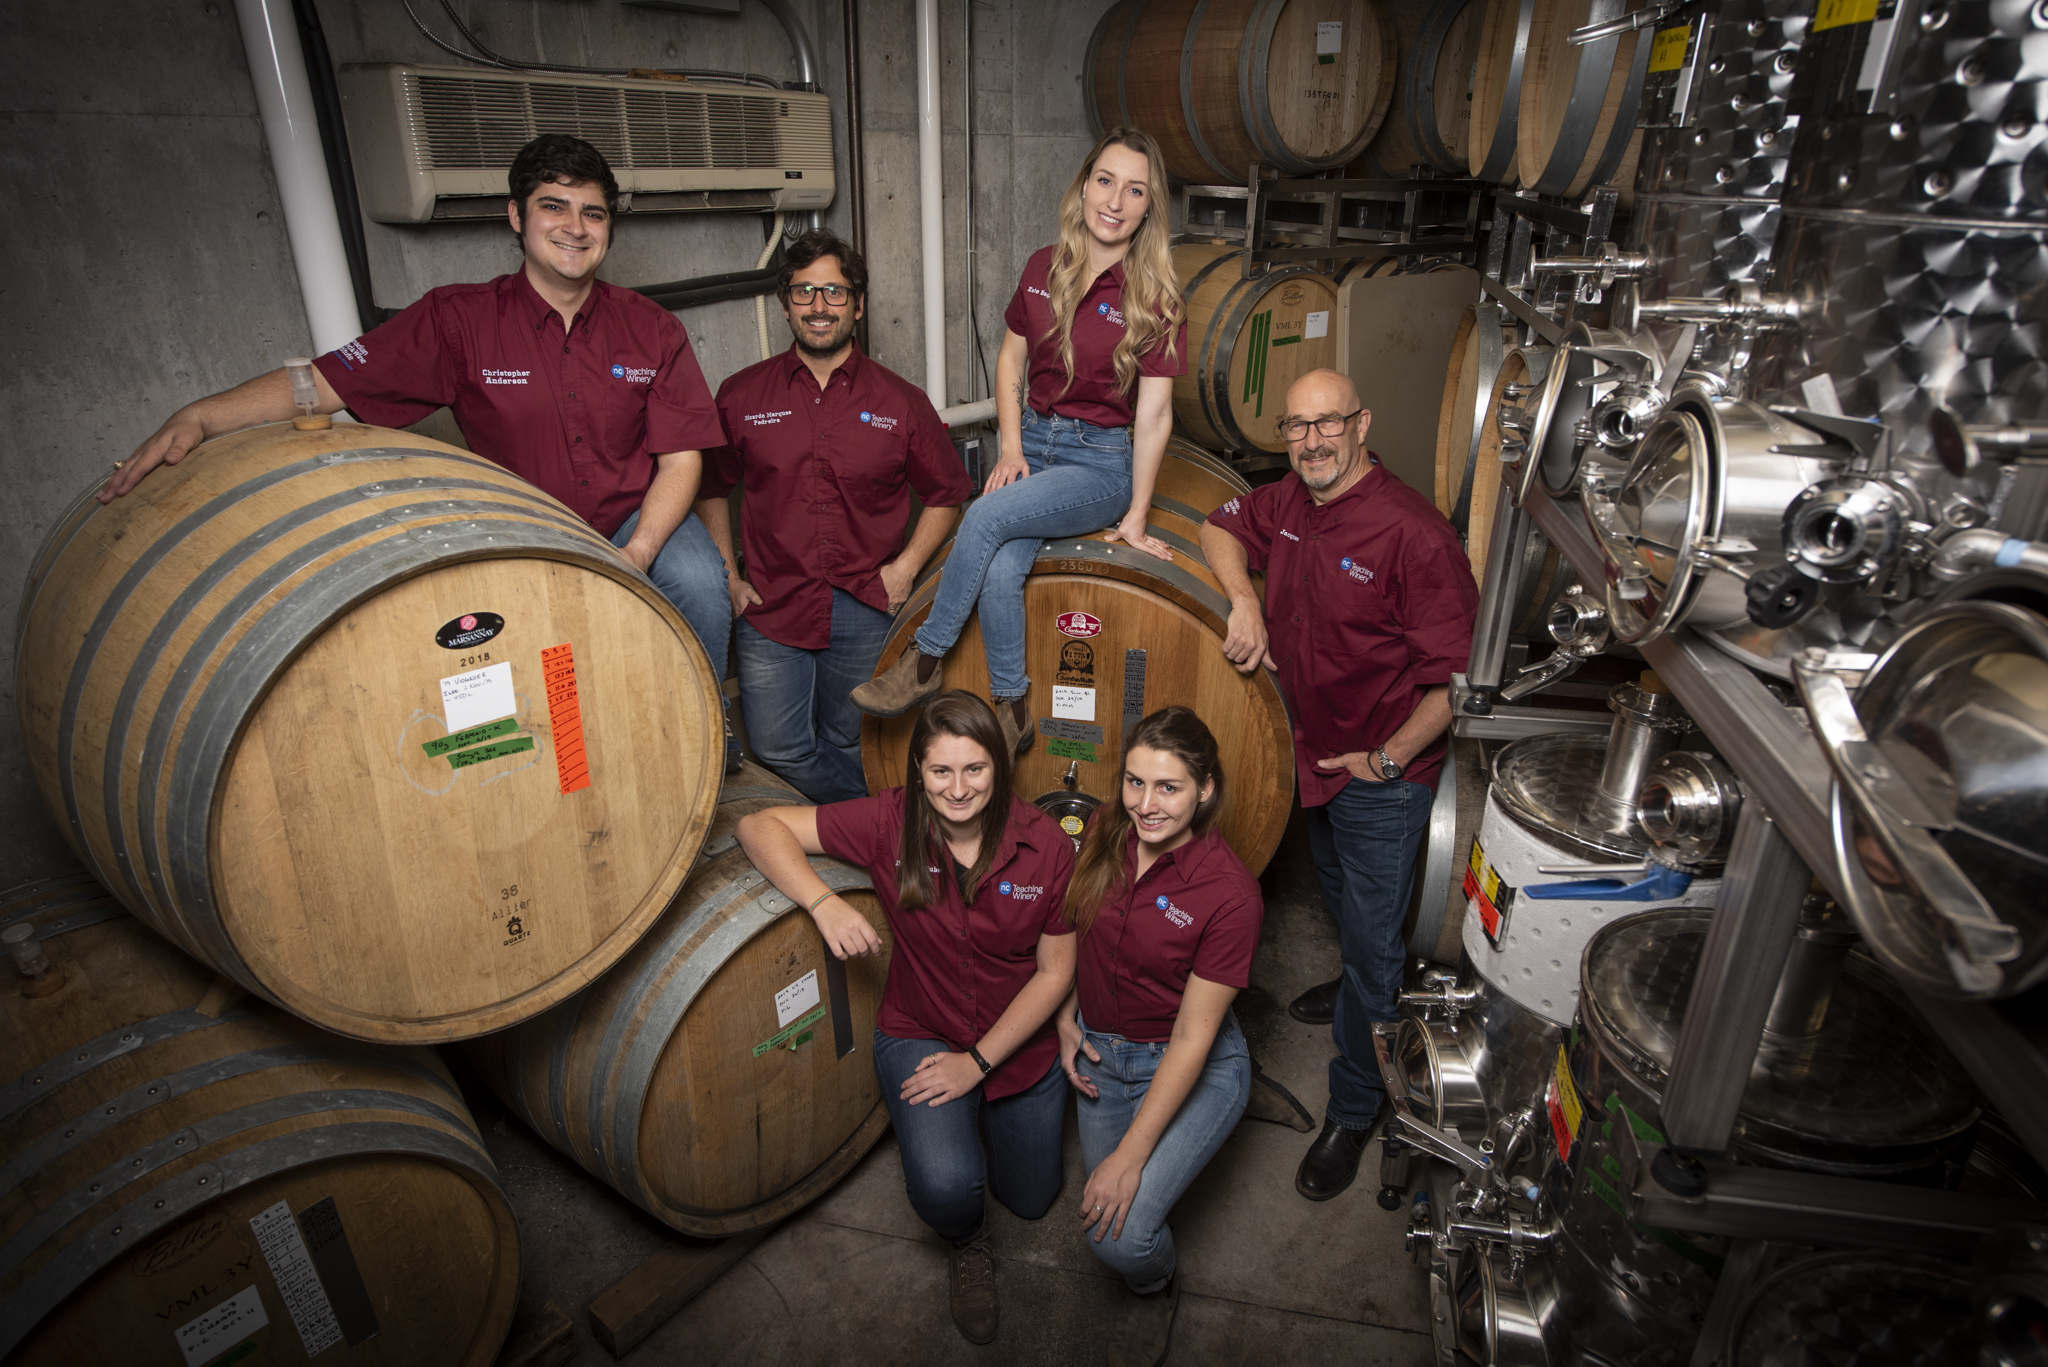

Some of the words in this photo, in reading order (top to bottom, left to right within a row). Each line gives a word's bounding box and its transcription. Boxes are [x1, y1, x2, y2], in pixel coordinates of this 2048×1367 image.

[1106, 313, 1127, 328] Winery
[1275, 321, 1292, 330] VML
[1293, 321, 1303, 329] 3Y
[482, 368, 531, 377] Christopher
[625, 367, 656, 377] Teaching
[485, 377, 528, 385] Anderson
[626, 374, 651, 384] Winery
[744, 413, 765, 421] Ricardo
[766, 410, 792, 419] Marques
[871, 414, 898, 426] Teaching
[753, 418, 781, 426] Pedreira
[871, 420, 893, 431] Winery
[1060, 561, 1093, 572] 2360
[1351, 562, 1374, 580] Teaching
[1349, 568, 1370, 584] Winery
[447, 628, 494, 647] MARSANNAY
[460, 652, 490, 668] 2018
[1069, 652, 1085, 660] 1775
[454, 672, 487, 686] VIOGNIER
[1012, 884, 1043, 895] Teaching
[1012, 892, 1037, 901] Winery
[1157, 898, 1167, 907] nc
[492, 898, 532, 921] Allier
[1168, 902, 1194, 926] Teaching
[1164, 909, 1187, 929] Winery
[144, 1220, 223, 1272] Billon
[155, 1284, 218, 1319] VML
[223, 1254, 253, 1282] 3Y
